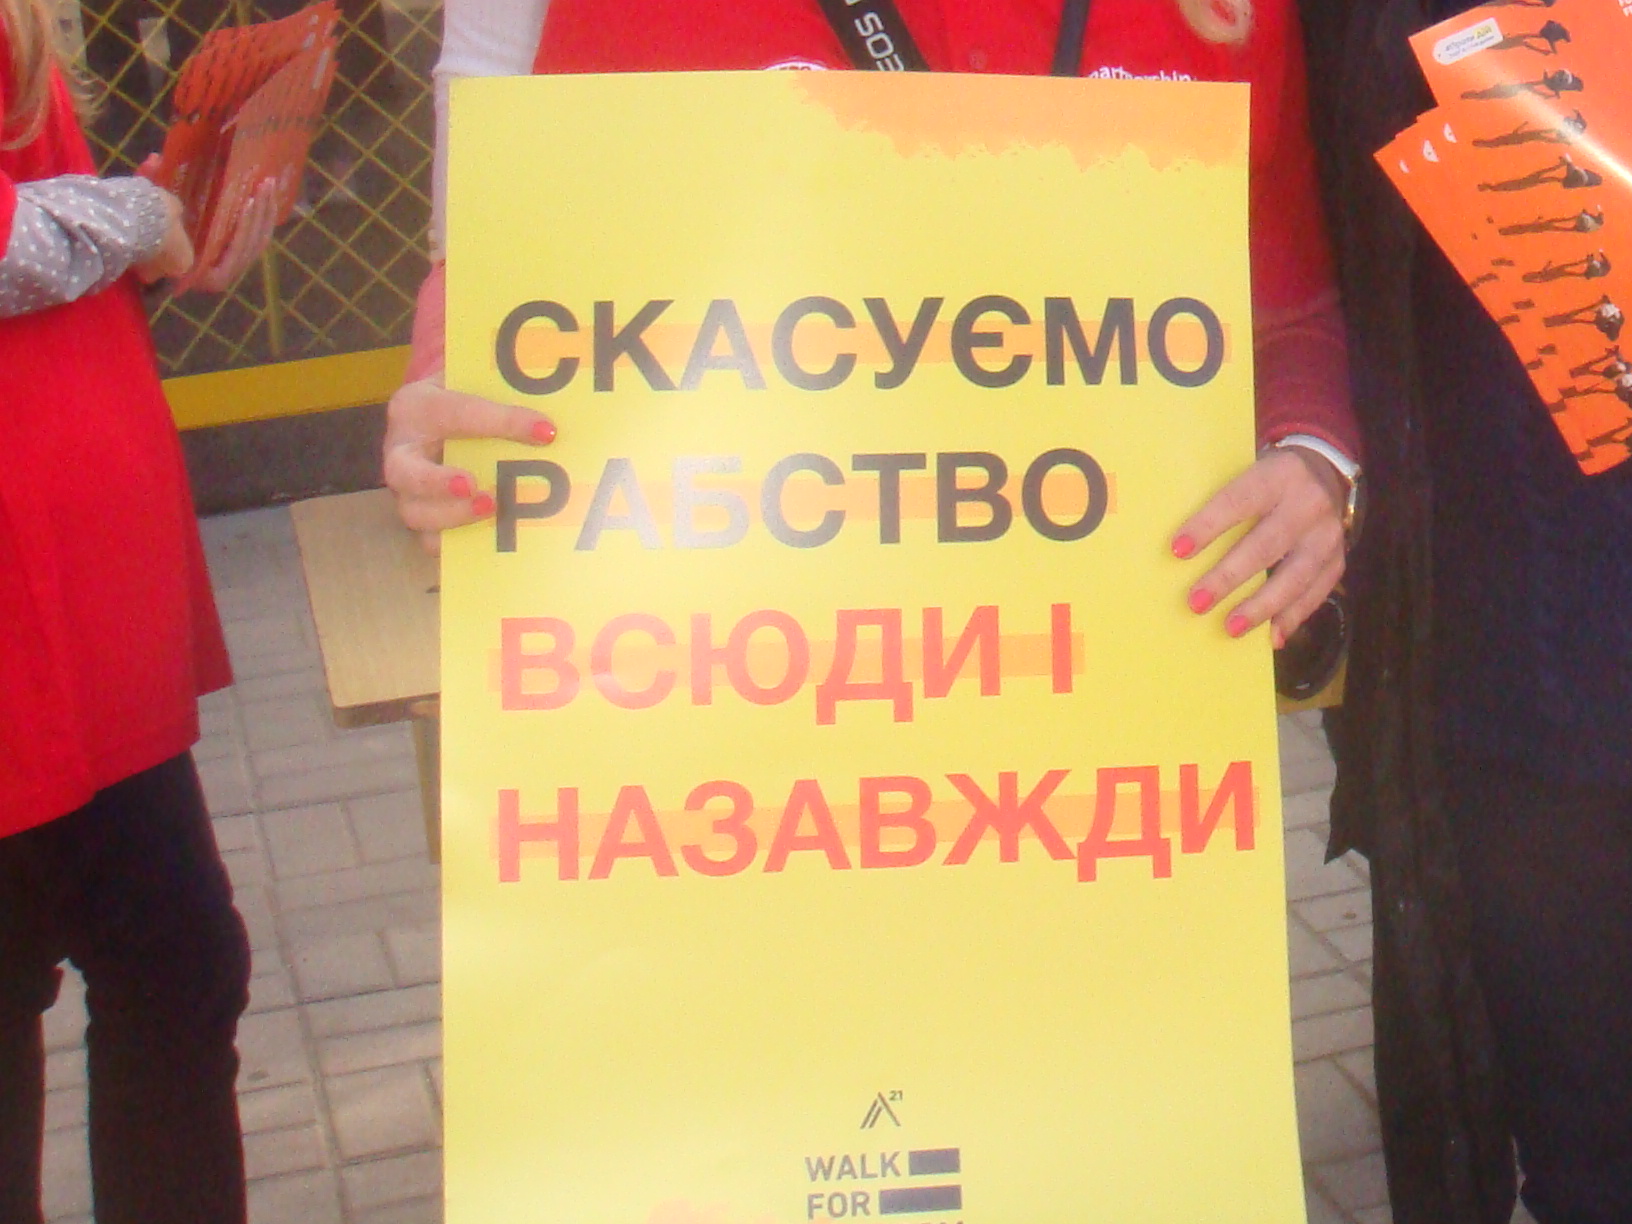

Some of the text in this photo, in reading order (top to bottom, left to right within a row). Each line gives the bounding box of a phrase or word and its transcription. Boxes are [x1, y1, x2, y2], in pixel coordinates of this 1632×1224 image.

[854, 11, 905, 72] EOS
[494, 295, 1227, 396] СКАСУЄМО
[494, 447, 1110, 554] РАБСТВО
[499, 602, 1074, 726] ВСЮДИ І
[496, 760, 1257, 884] НАЗАВЖДИ
[804, 1151, 902, 1183] WALK
[807, 1190, 871, 1221] FOR
